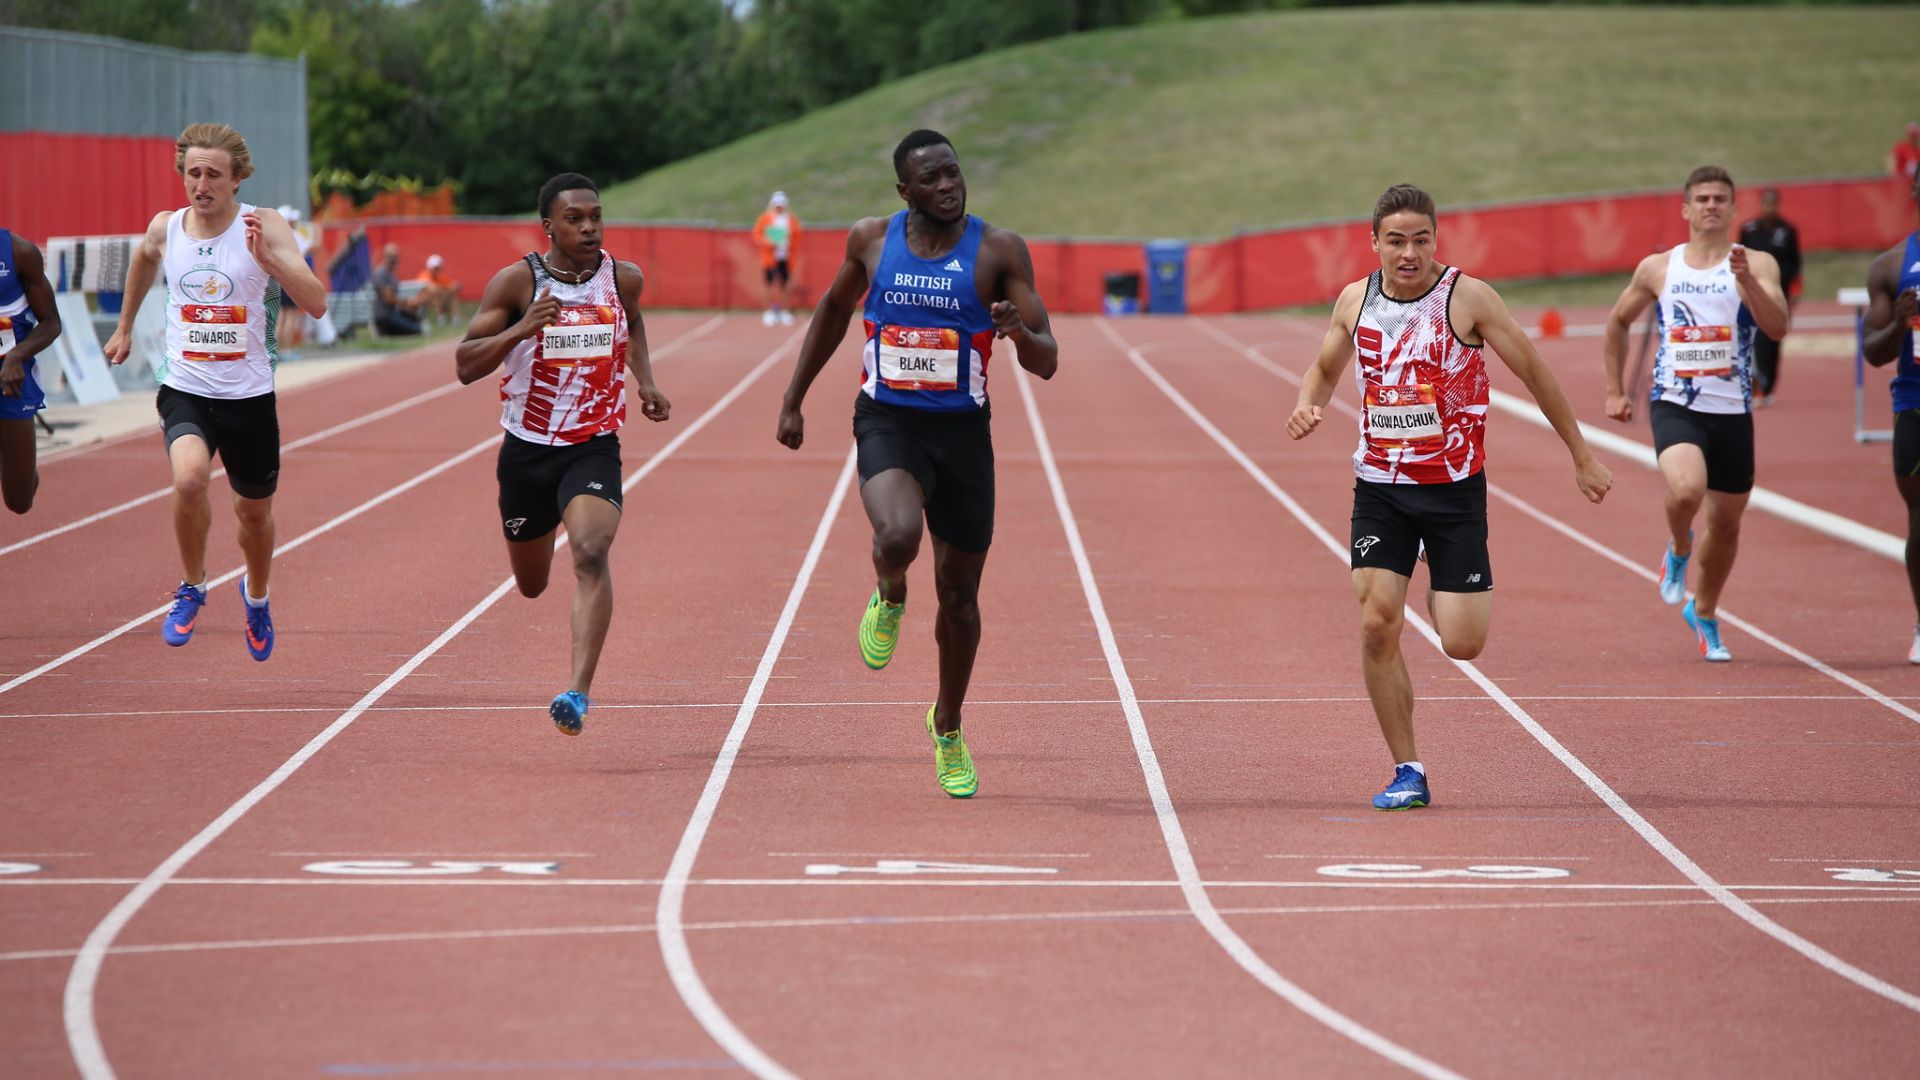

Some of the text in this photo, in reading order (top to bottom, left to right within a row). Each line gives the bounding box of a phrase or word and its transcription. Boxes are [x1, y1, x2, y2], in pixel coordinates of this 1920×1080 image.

[894, 273, 952, 291] BRITISH
[1671, 281, 1727, 294] alberta
[884, 291, 960, 310] COLUMBIA
[189, 330, 237, 344] EDWARDS
[545, 332, 612, 349] STEWART-BAYNES
[1675, 349, 1725, 361] BUBELENYI
[900, 356, 936, 372] BLAKE
[1371, 411, 1437, 429] KOWALCHUK
